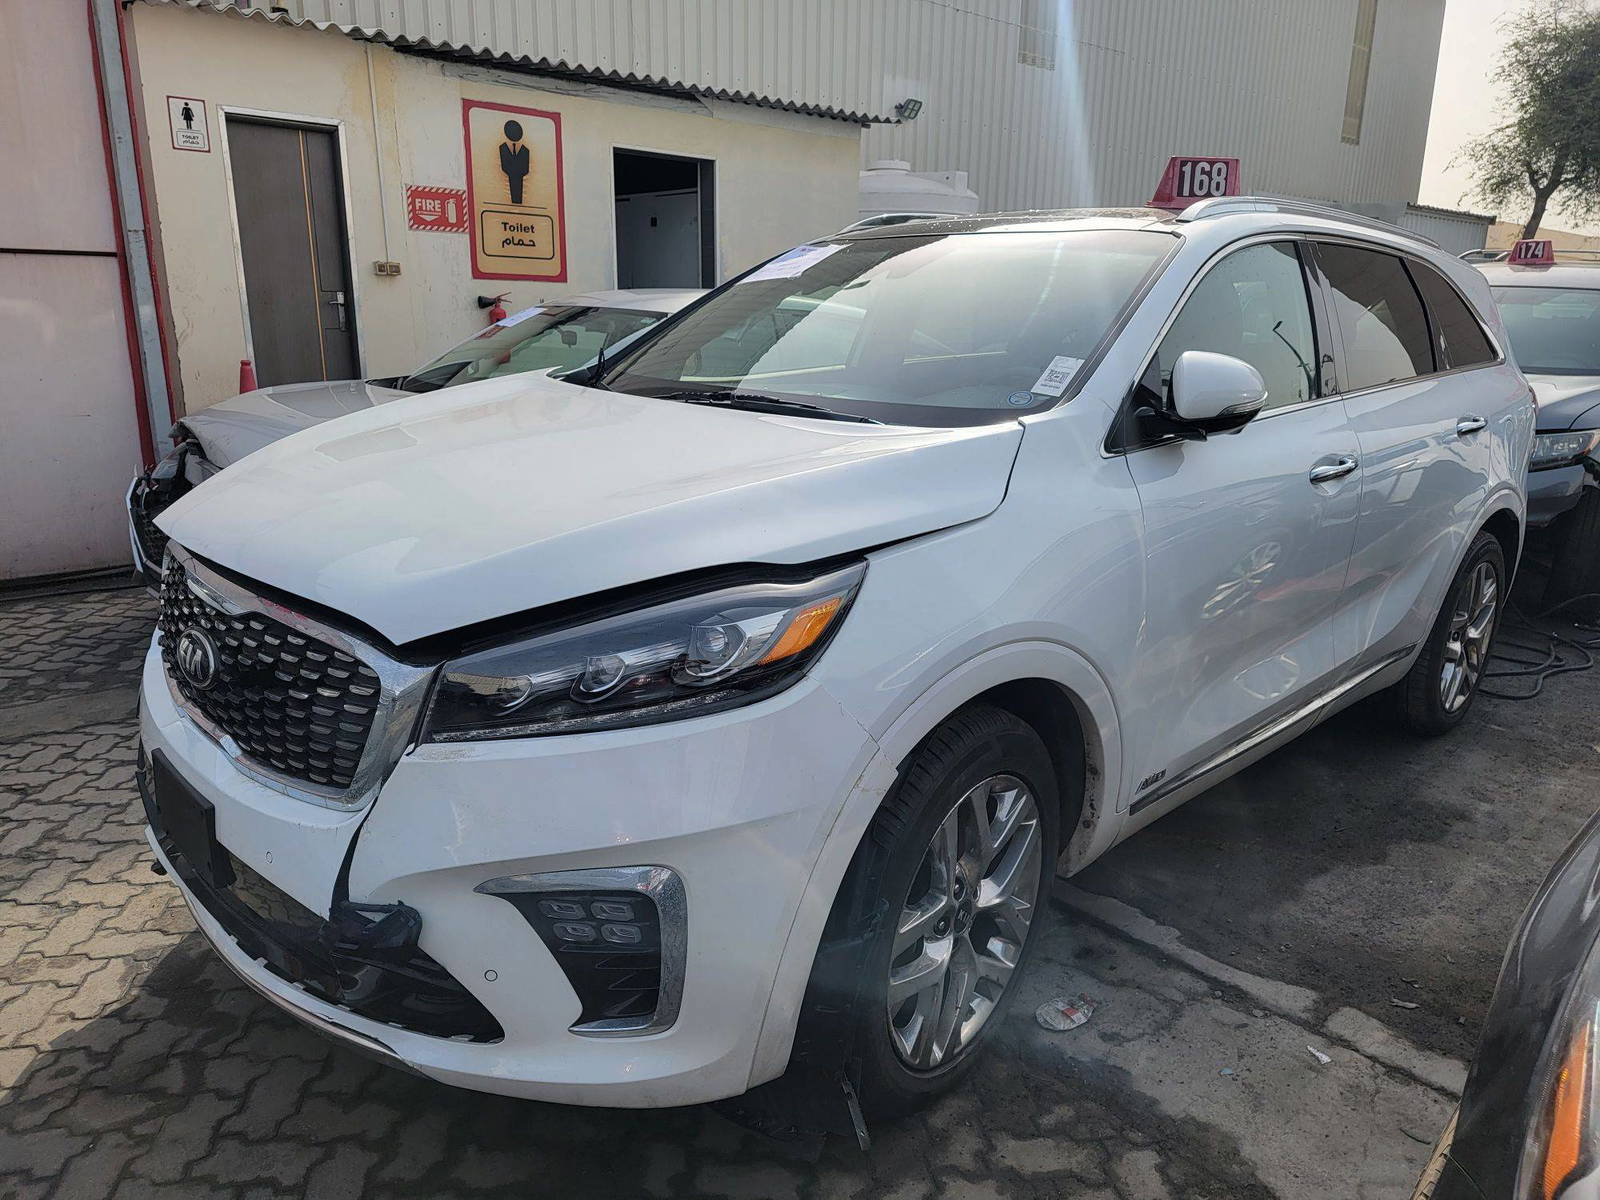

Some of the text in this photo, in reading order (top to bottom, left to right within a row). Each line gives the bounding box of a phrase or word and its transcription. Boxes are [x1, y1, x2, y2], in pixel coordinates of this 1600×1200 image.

[1182, 161, 1227, 197] 168
[415, 198, 442, 212] FIRE
[501, 221, 536, 234] Toilet
[502, 236, 536, 248] حمام
[1520, 242, 1544, 259] 174
